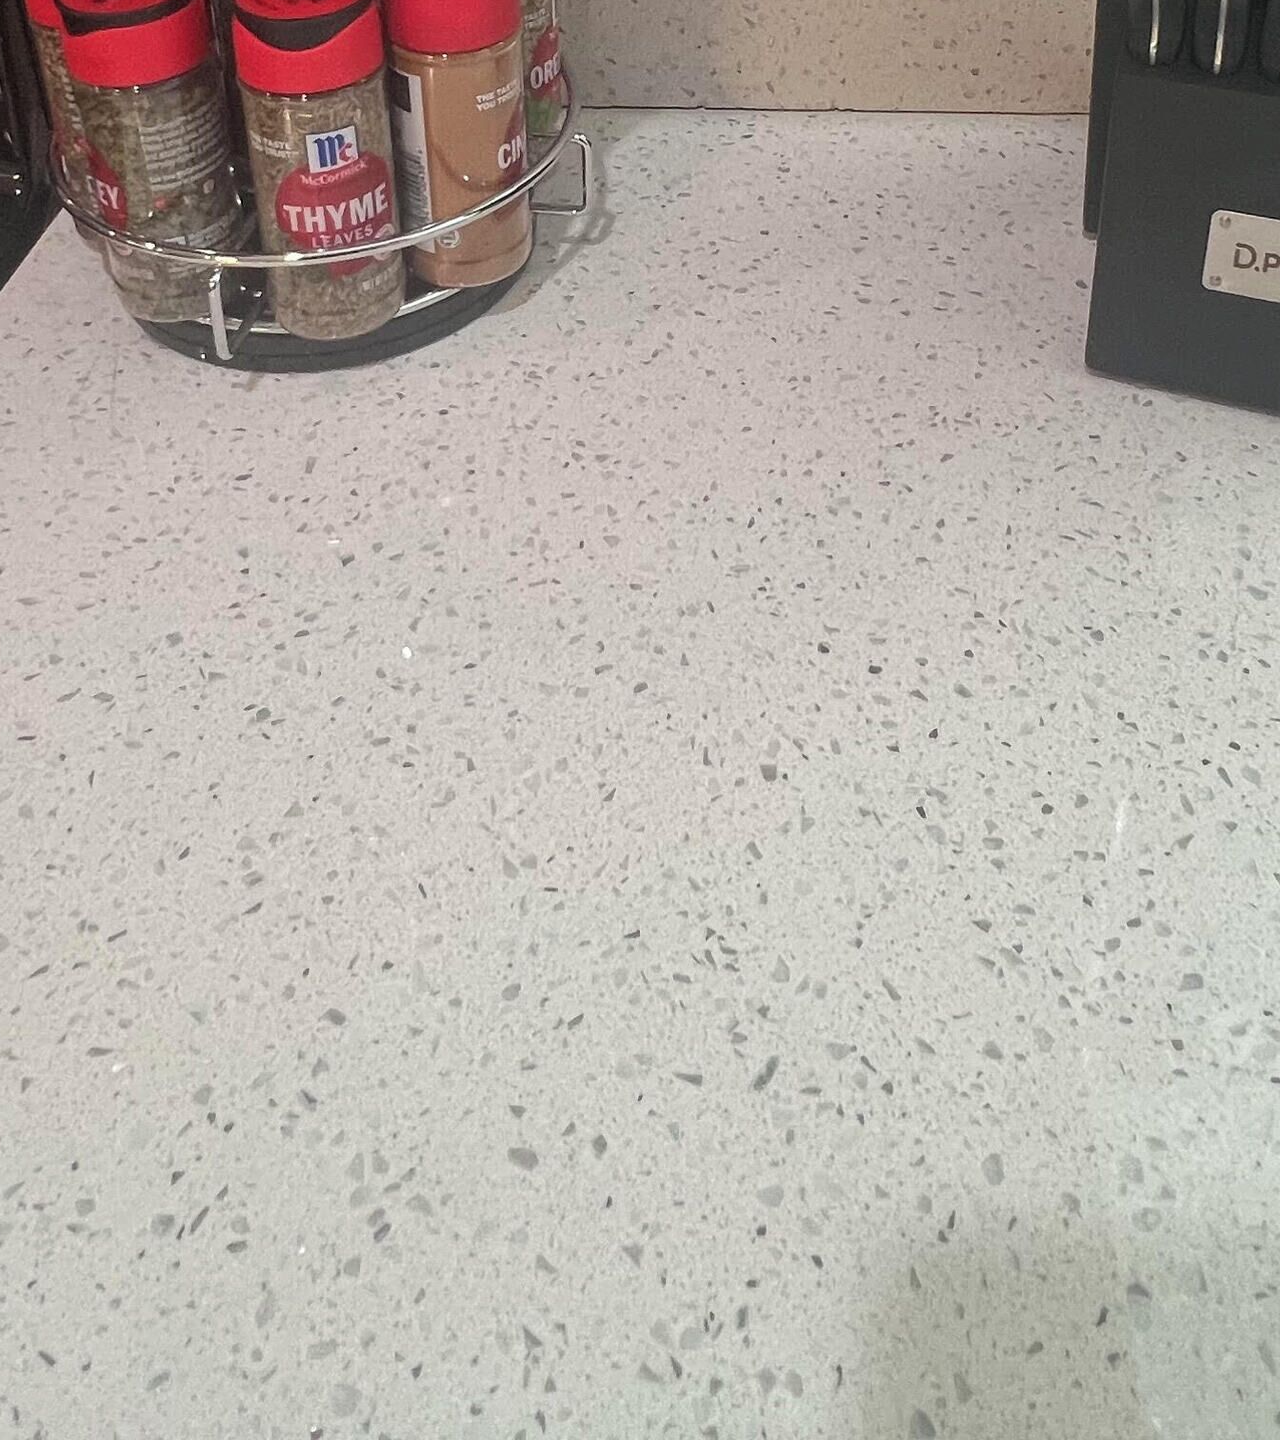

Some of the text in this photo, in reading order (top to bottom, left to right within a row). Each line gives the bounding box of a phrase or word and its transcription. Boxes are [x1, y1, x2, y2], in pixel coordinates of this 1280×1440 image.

[300, 160, 368, 186] McCormick
[282, 181, 389, 233] THYME
[311, 224, 374, 249] LEAVES
